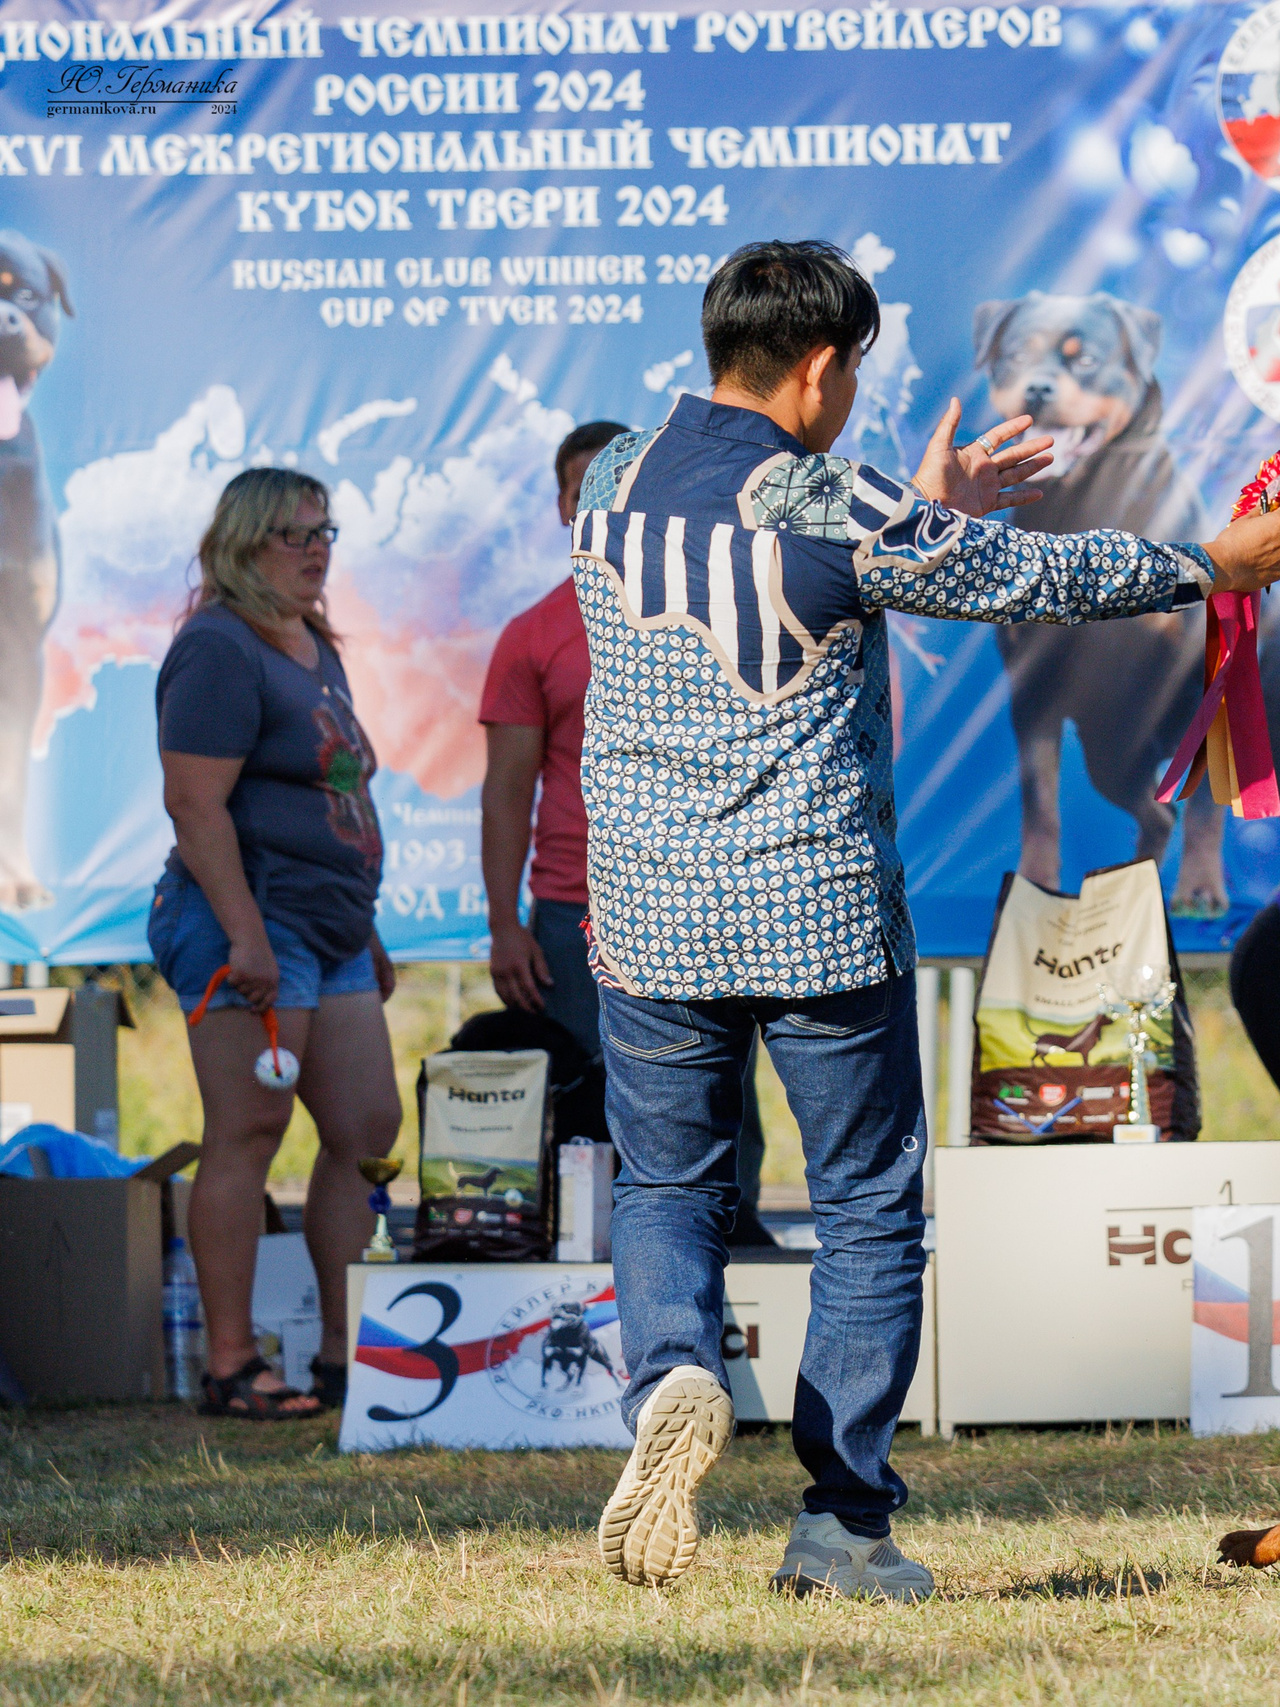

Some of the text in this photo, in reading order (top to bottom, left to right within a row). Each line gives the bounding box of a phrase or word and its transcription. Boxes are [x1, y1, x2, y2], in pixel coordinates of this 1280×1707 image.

[0, 1, 1063, 62] ИОНАЛЬНЫЙ ЧЕМПИОНАТ РОТВЕЙЛЕРОВ
[312, 69, 647, 117] РОССИИ 2024
[99, 119, 654, 177] МЕЖРЕГИОНАЛЬНЫЙ
[668, 121, 1012, 169] ЧЕМПИОНАТ
[236, 184, 729, 233] КУБОК ТВЕРИ 2024
[231, 257, 386, 293] RUSSIAN
[395, 256, 492, 288] CLUB
[501, 254, 647, 286] WINNER
[319, 294, 643, 329] CUP OF TVER 2024
[448, 1086, 526, 1103] Hanta
[367, 1281, 463, 1422] 3
